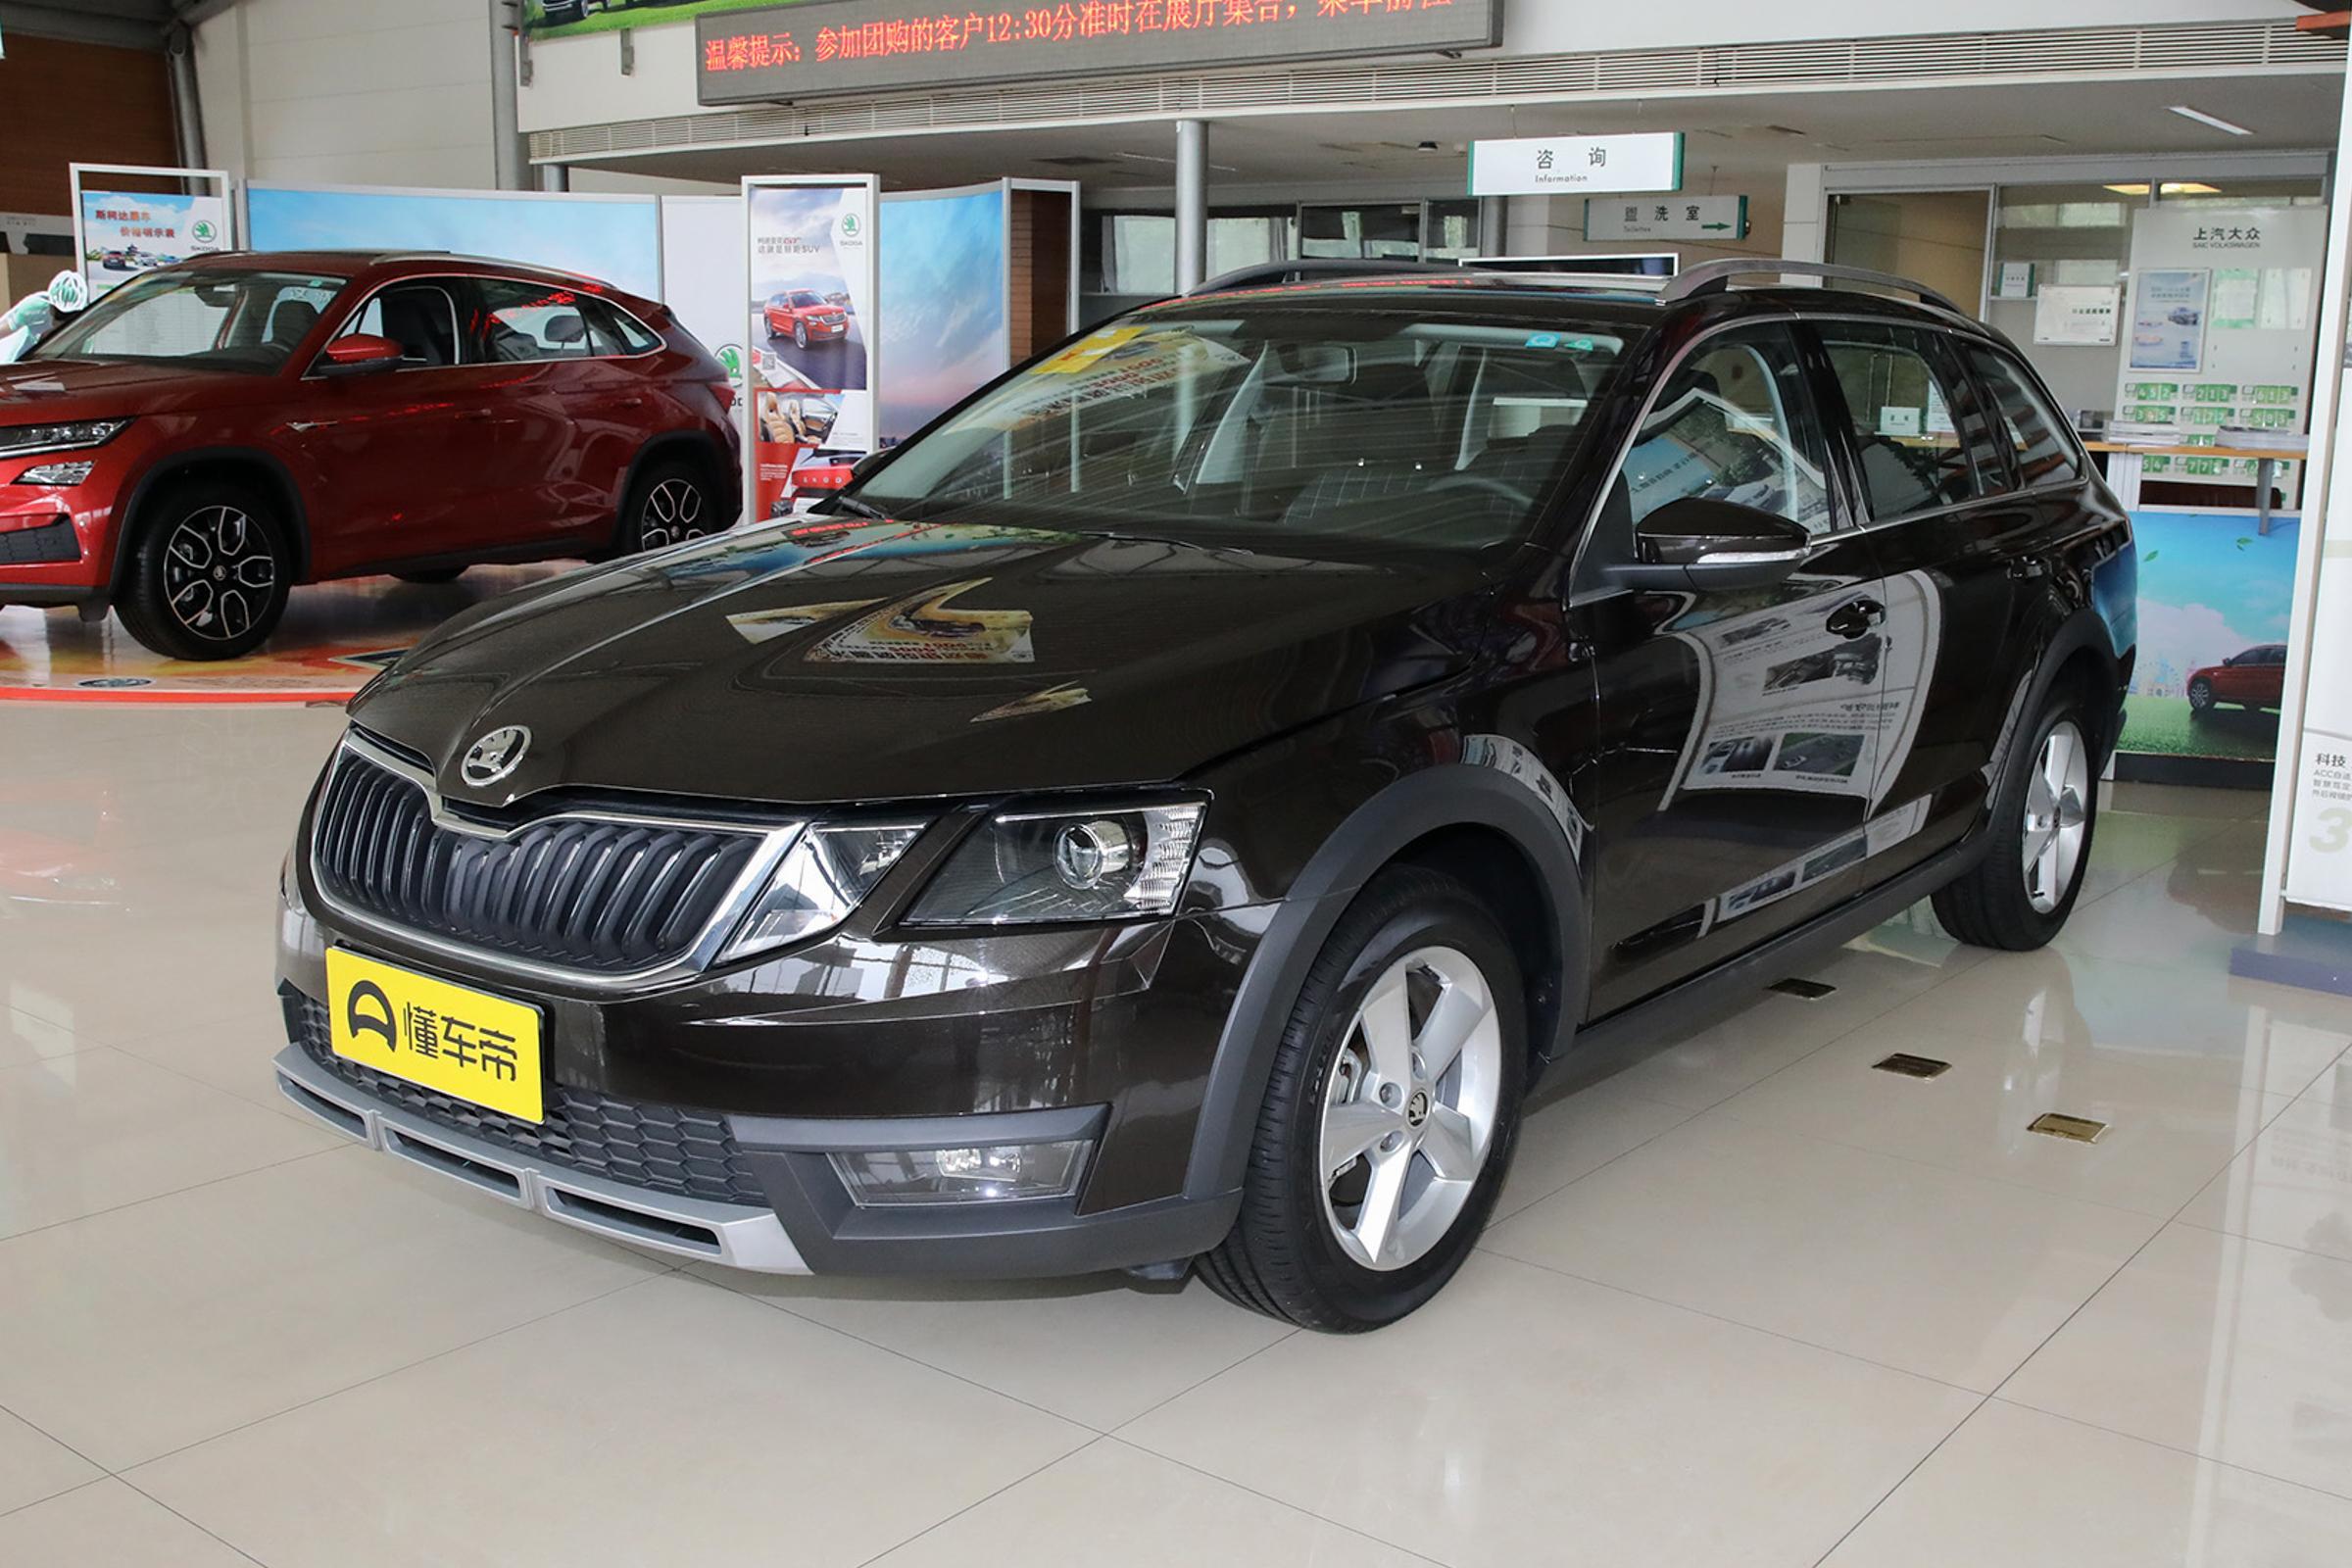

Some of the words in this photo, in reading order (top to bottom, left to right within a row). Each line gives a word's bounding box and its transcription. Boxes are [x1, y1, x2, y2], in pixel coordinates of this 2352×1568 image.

[1536, 147, 1607, 170] 咨询
[1535, 174, 1588, 183] Information
[2193, 226, 2260, 241] 上汽大众
[2197, 388, 2228, 400] 213
[2316, 753, 2346, 768] 科技
[2309, 808, 2352, 853] 3
[403, 1002, 518, 1082] 懂车帝
